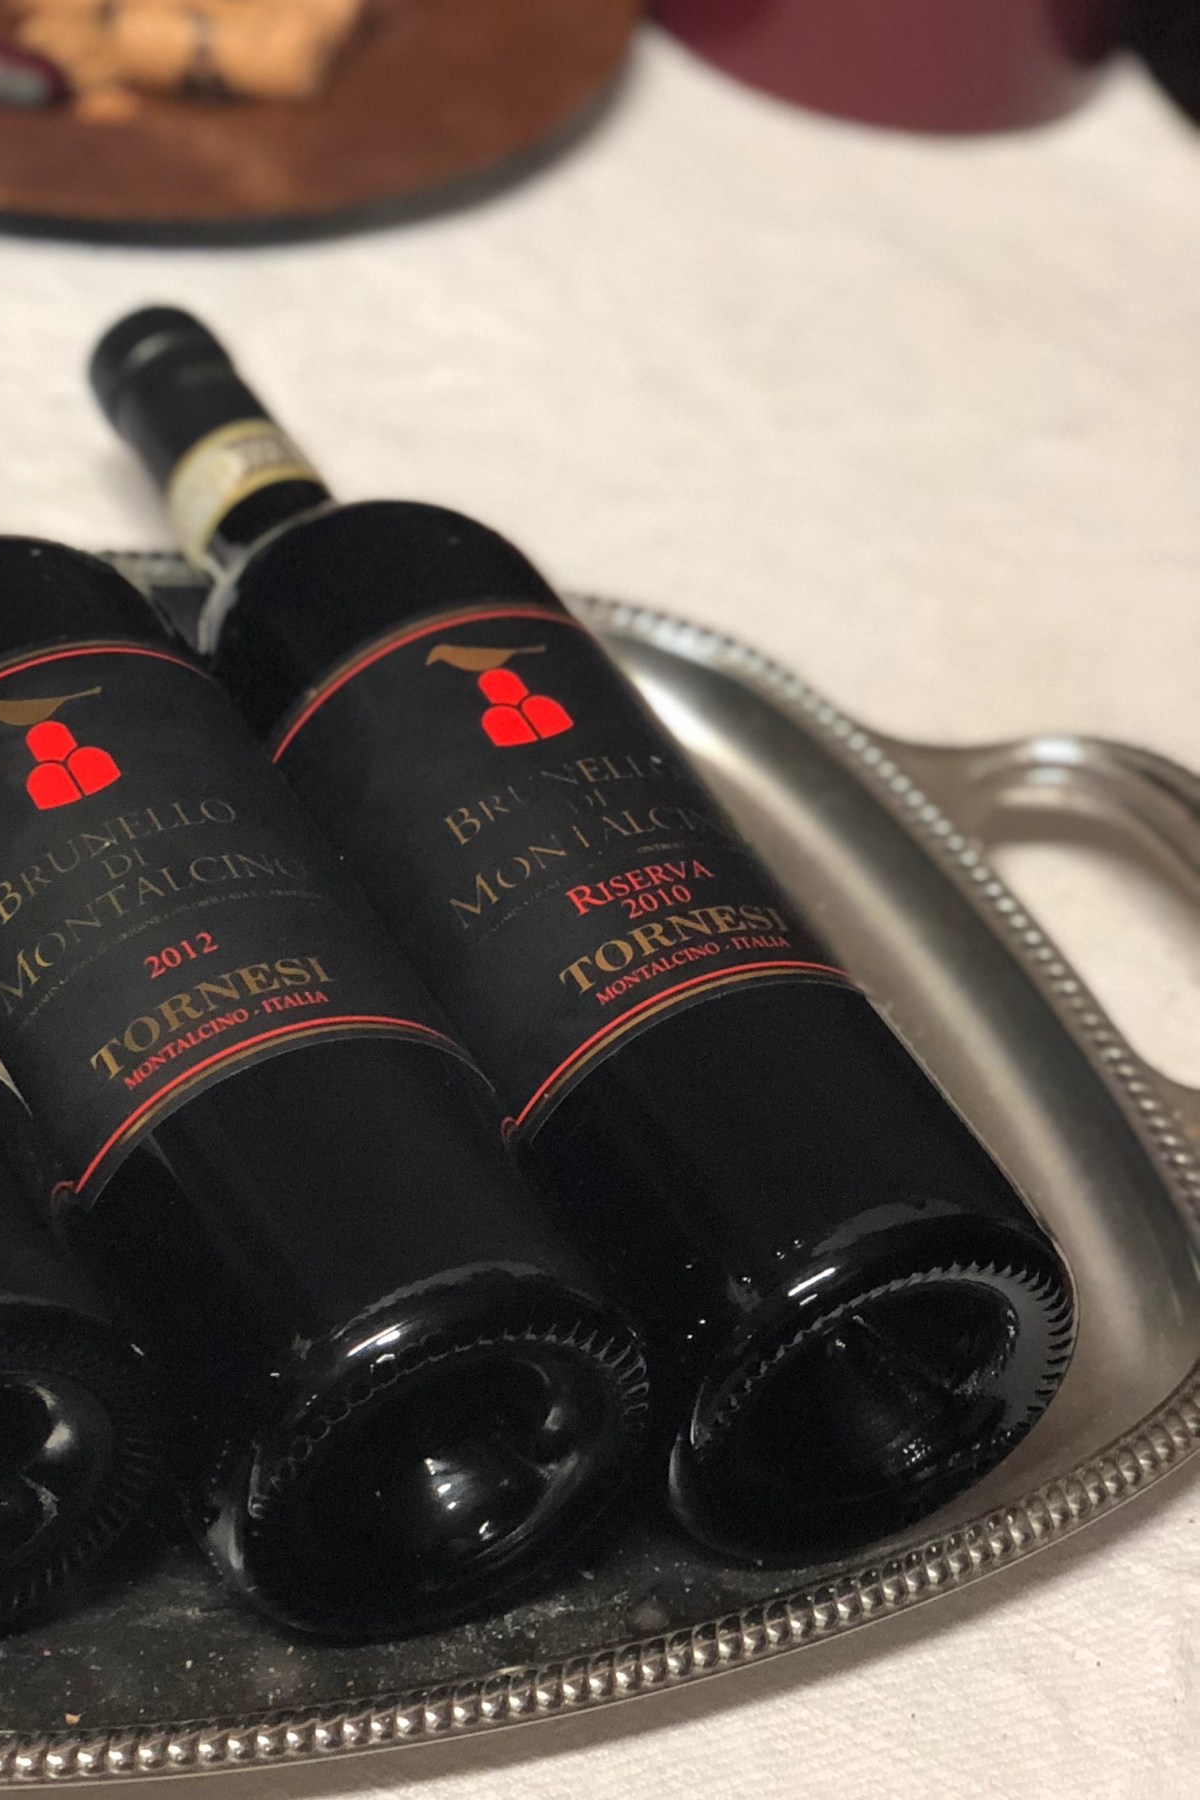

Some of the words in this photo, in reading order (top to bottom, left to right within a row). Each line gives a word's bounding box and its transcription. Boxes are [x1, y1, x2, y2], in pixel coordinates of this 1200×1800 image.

[101, 848, 148, 880] DI
[564, 859, 715, 916] RISERVA
[620, 884, 693, 920] 2010
[143, 931, 220, 981] 2012
[558, 904, 792, 997] TORNESI
[595, 941, 721, 1006] MONTALCINO
[731, 934, 791, 951] ITALIA
[89, 955, 337, 1083] TORNESI
[123, 1008, 250, 1091] MONTALCINO
[261, 990, 330, 1014] ITALIA
